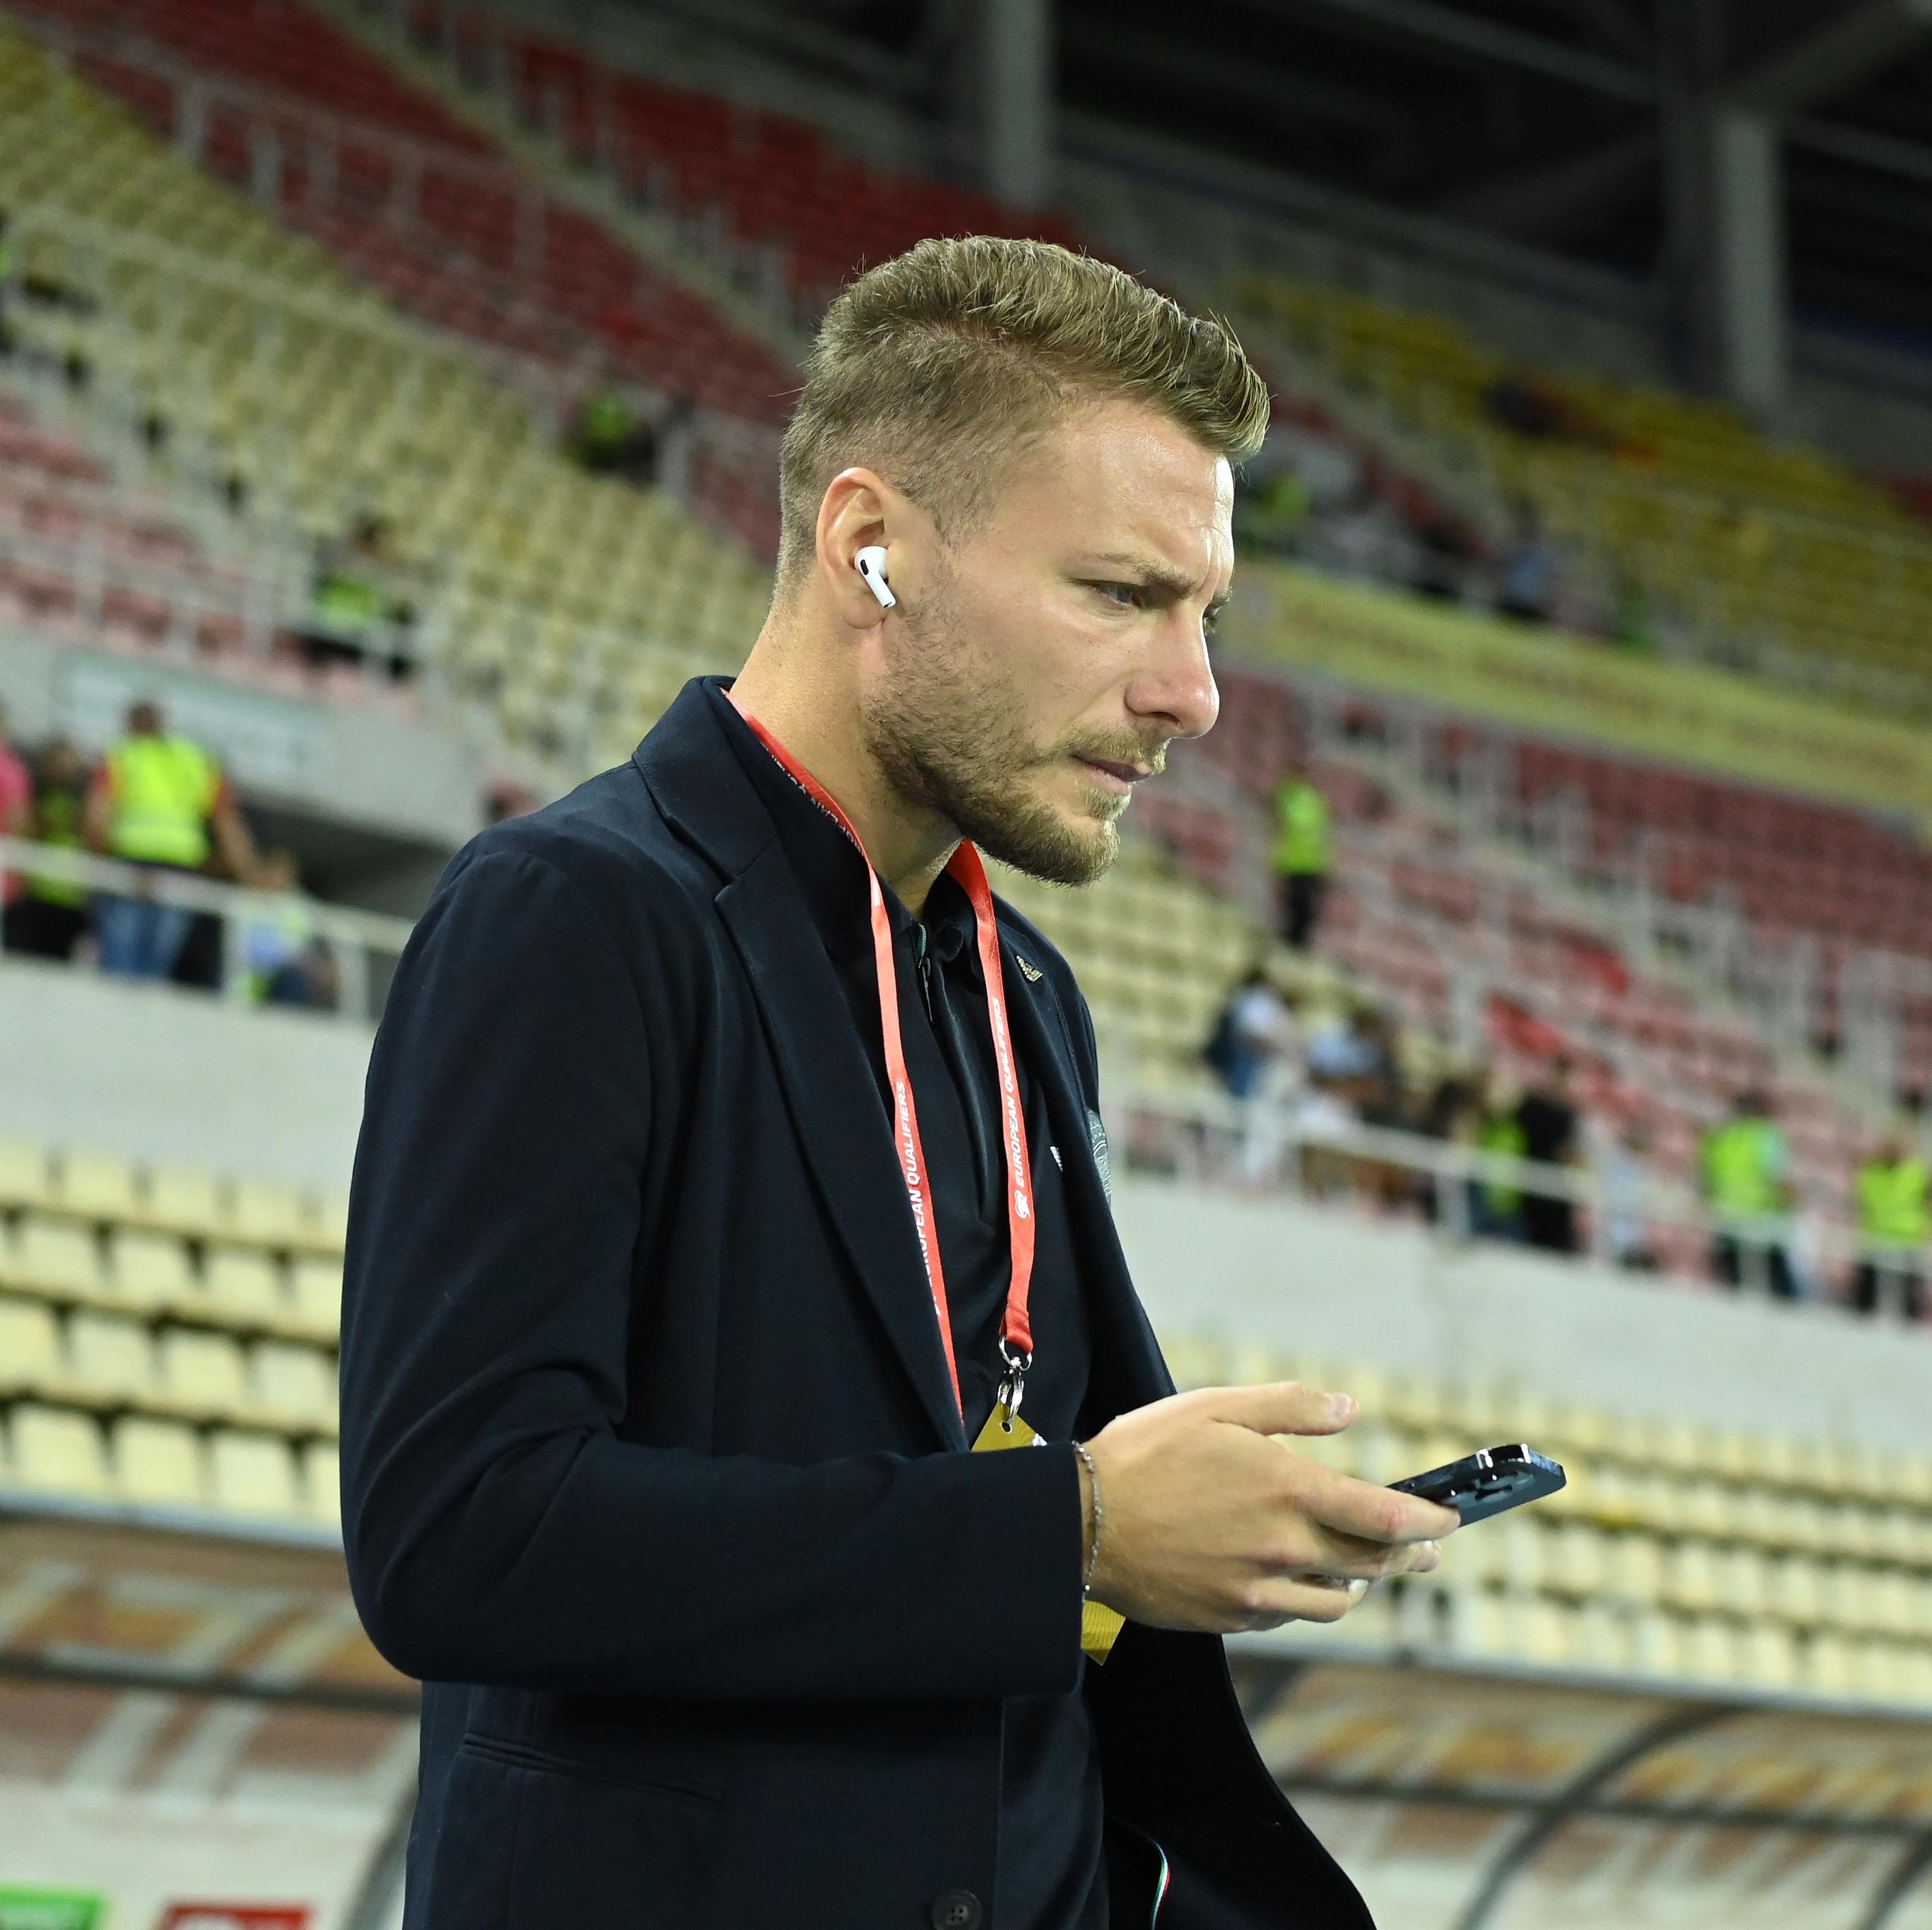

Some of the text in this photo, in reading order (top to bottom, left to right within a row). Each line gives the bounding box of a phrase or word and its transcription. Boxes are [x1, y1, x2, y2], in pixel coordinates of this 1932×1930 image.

[896, 1082, 920, 1185] QUALIFIERS
[992, 996, 1025, 1188] EUROPEAN QUALIFIERS
